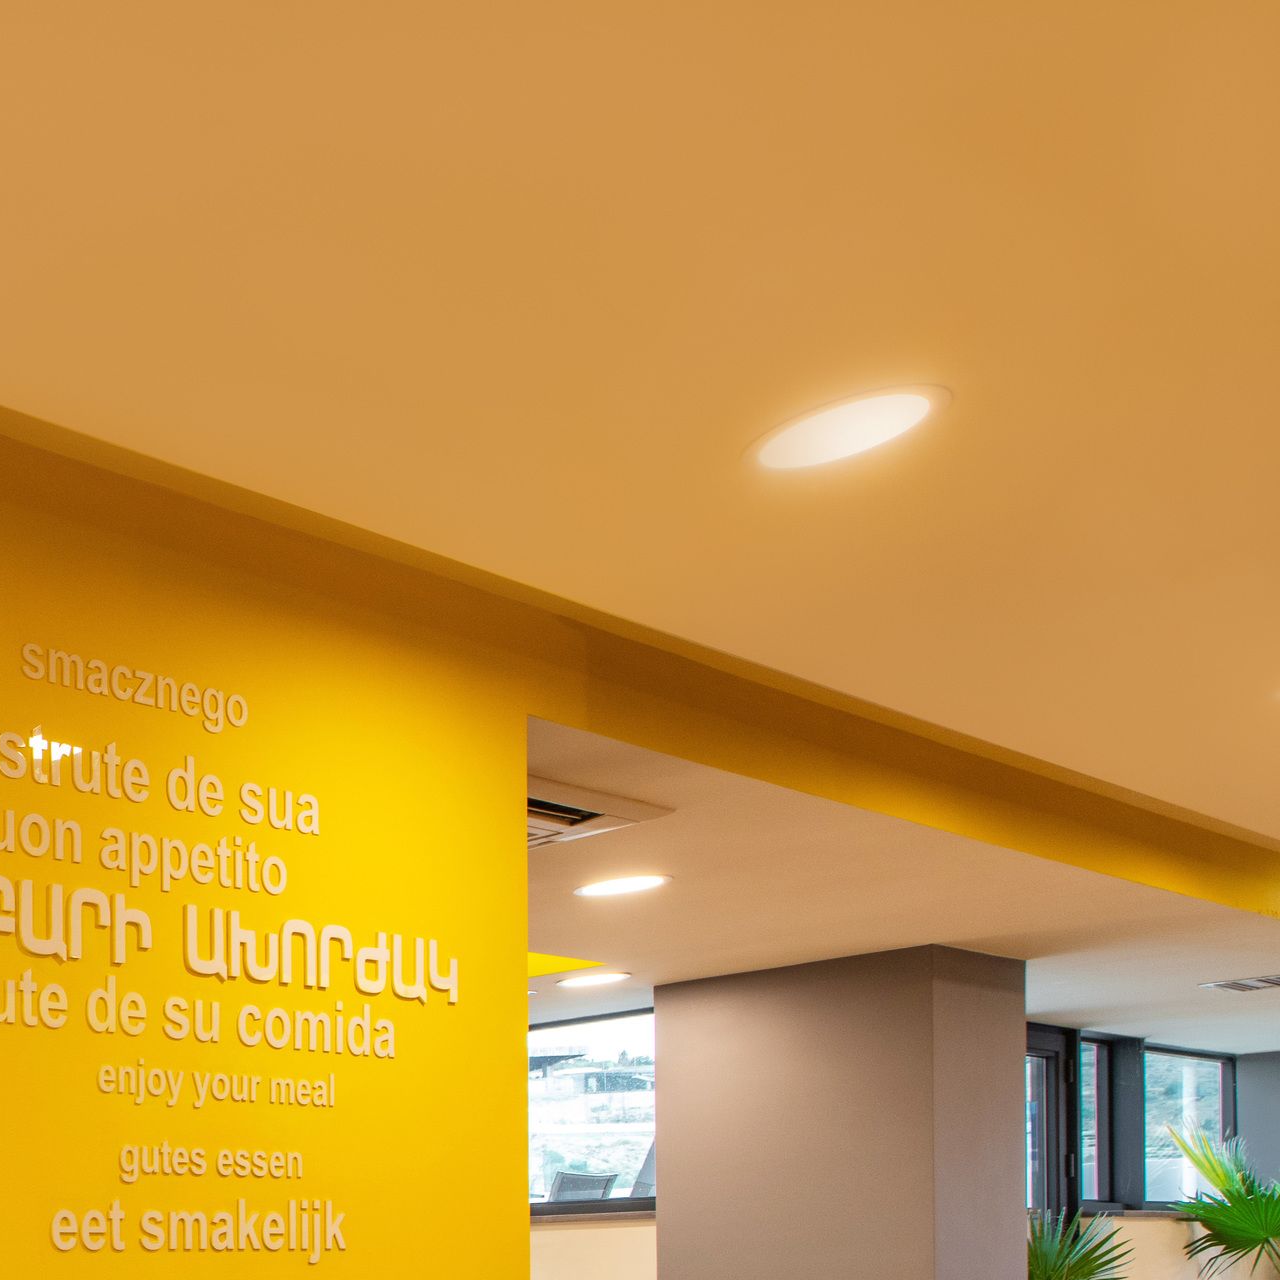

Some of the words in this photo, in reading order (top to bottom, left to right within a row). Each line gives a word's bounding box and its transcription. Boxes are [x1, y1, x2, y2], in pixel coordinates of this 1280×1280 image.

[21, 641, 249, 734] smacznego
[167, 754, 225, 817] de
[240, 781, 321, 836] sua
[100, 827, 289, 896] appetito
[87, 974, 148, 1036] de
[164, 996, 221, 1043] su
[237, 999, 396, 1059] comida
[99, 1059, 185, 1107] enjoy
[194, 1072, 261, 1109] your
[270, 1073, 336, 1107] meal
[120, 1141, 208, 1184] gutes
[217, 1148, 304, 1178] essen
[51, 1199, 126, 1252] eet
[141, 1198, 347, 1265] smakelijk
